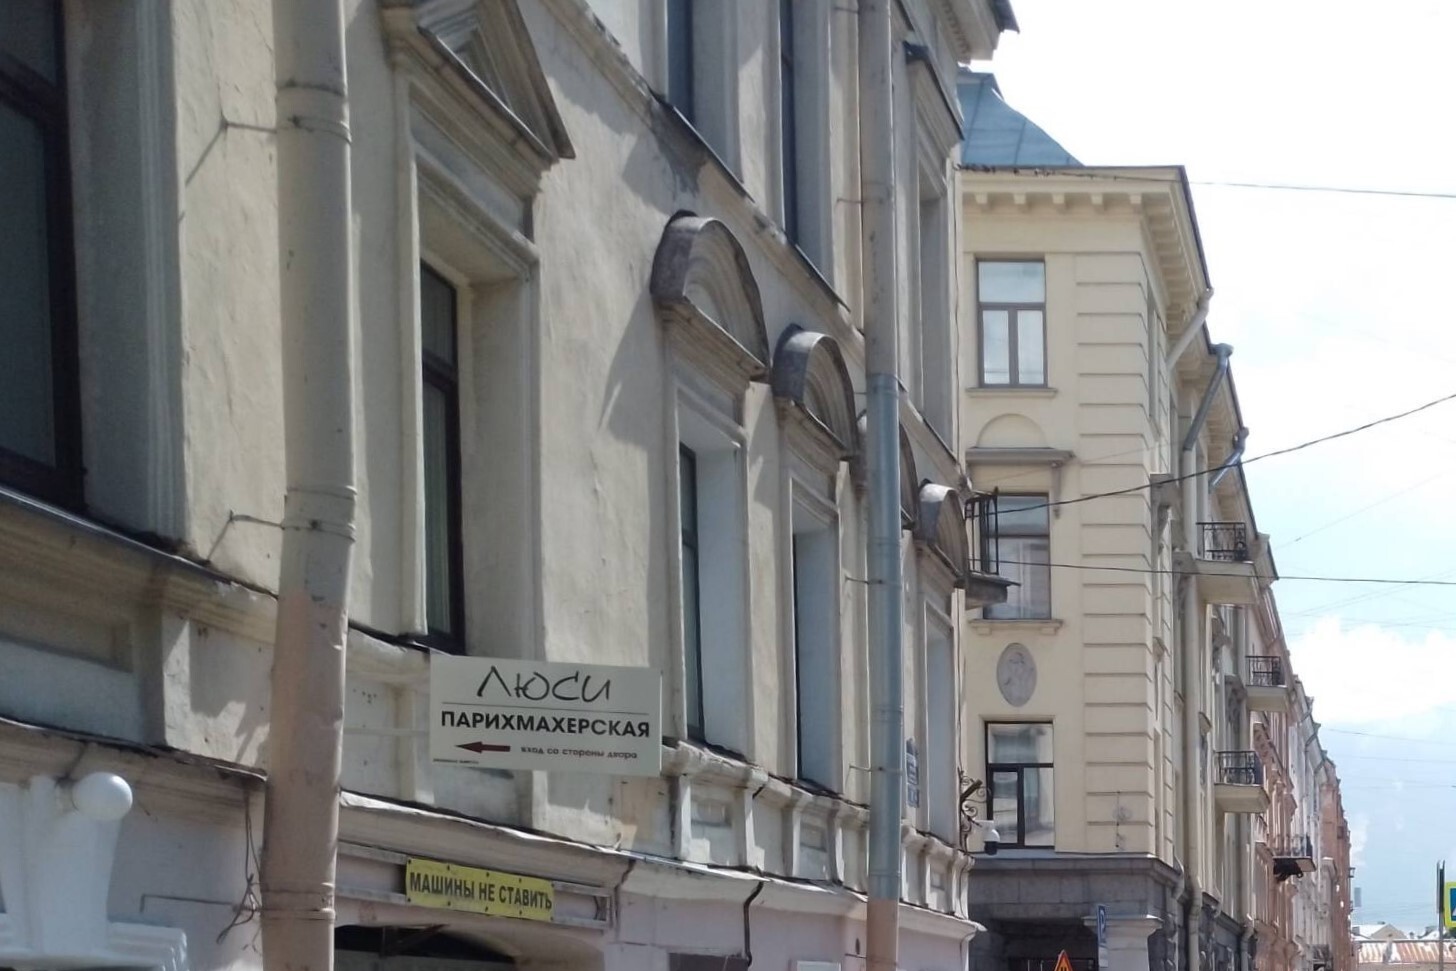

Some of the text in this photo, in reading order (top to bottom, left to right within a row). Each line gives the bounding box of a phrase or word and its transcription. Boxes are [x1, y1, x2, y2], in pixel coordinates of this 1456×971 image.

[476, 665, 611, 703] ЛЮСИ
[441, 710, 650, 738] ПАРИХМАХЕРСКАЯ
[520, 746, 545, 755] вход
[547, 747, 559, 755] со
[562, 748, 605, 759] стороны
[409, 872, 553, 911] МАШИНЫ НЕ СТАВИТЬ
